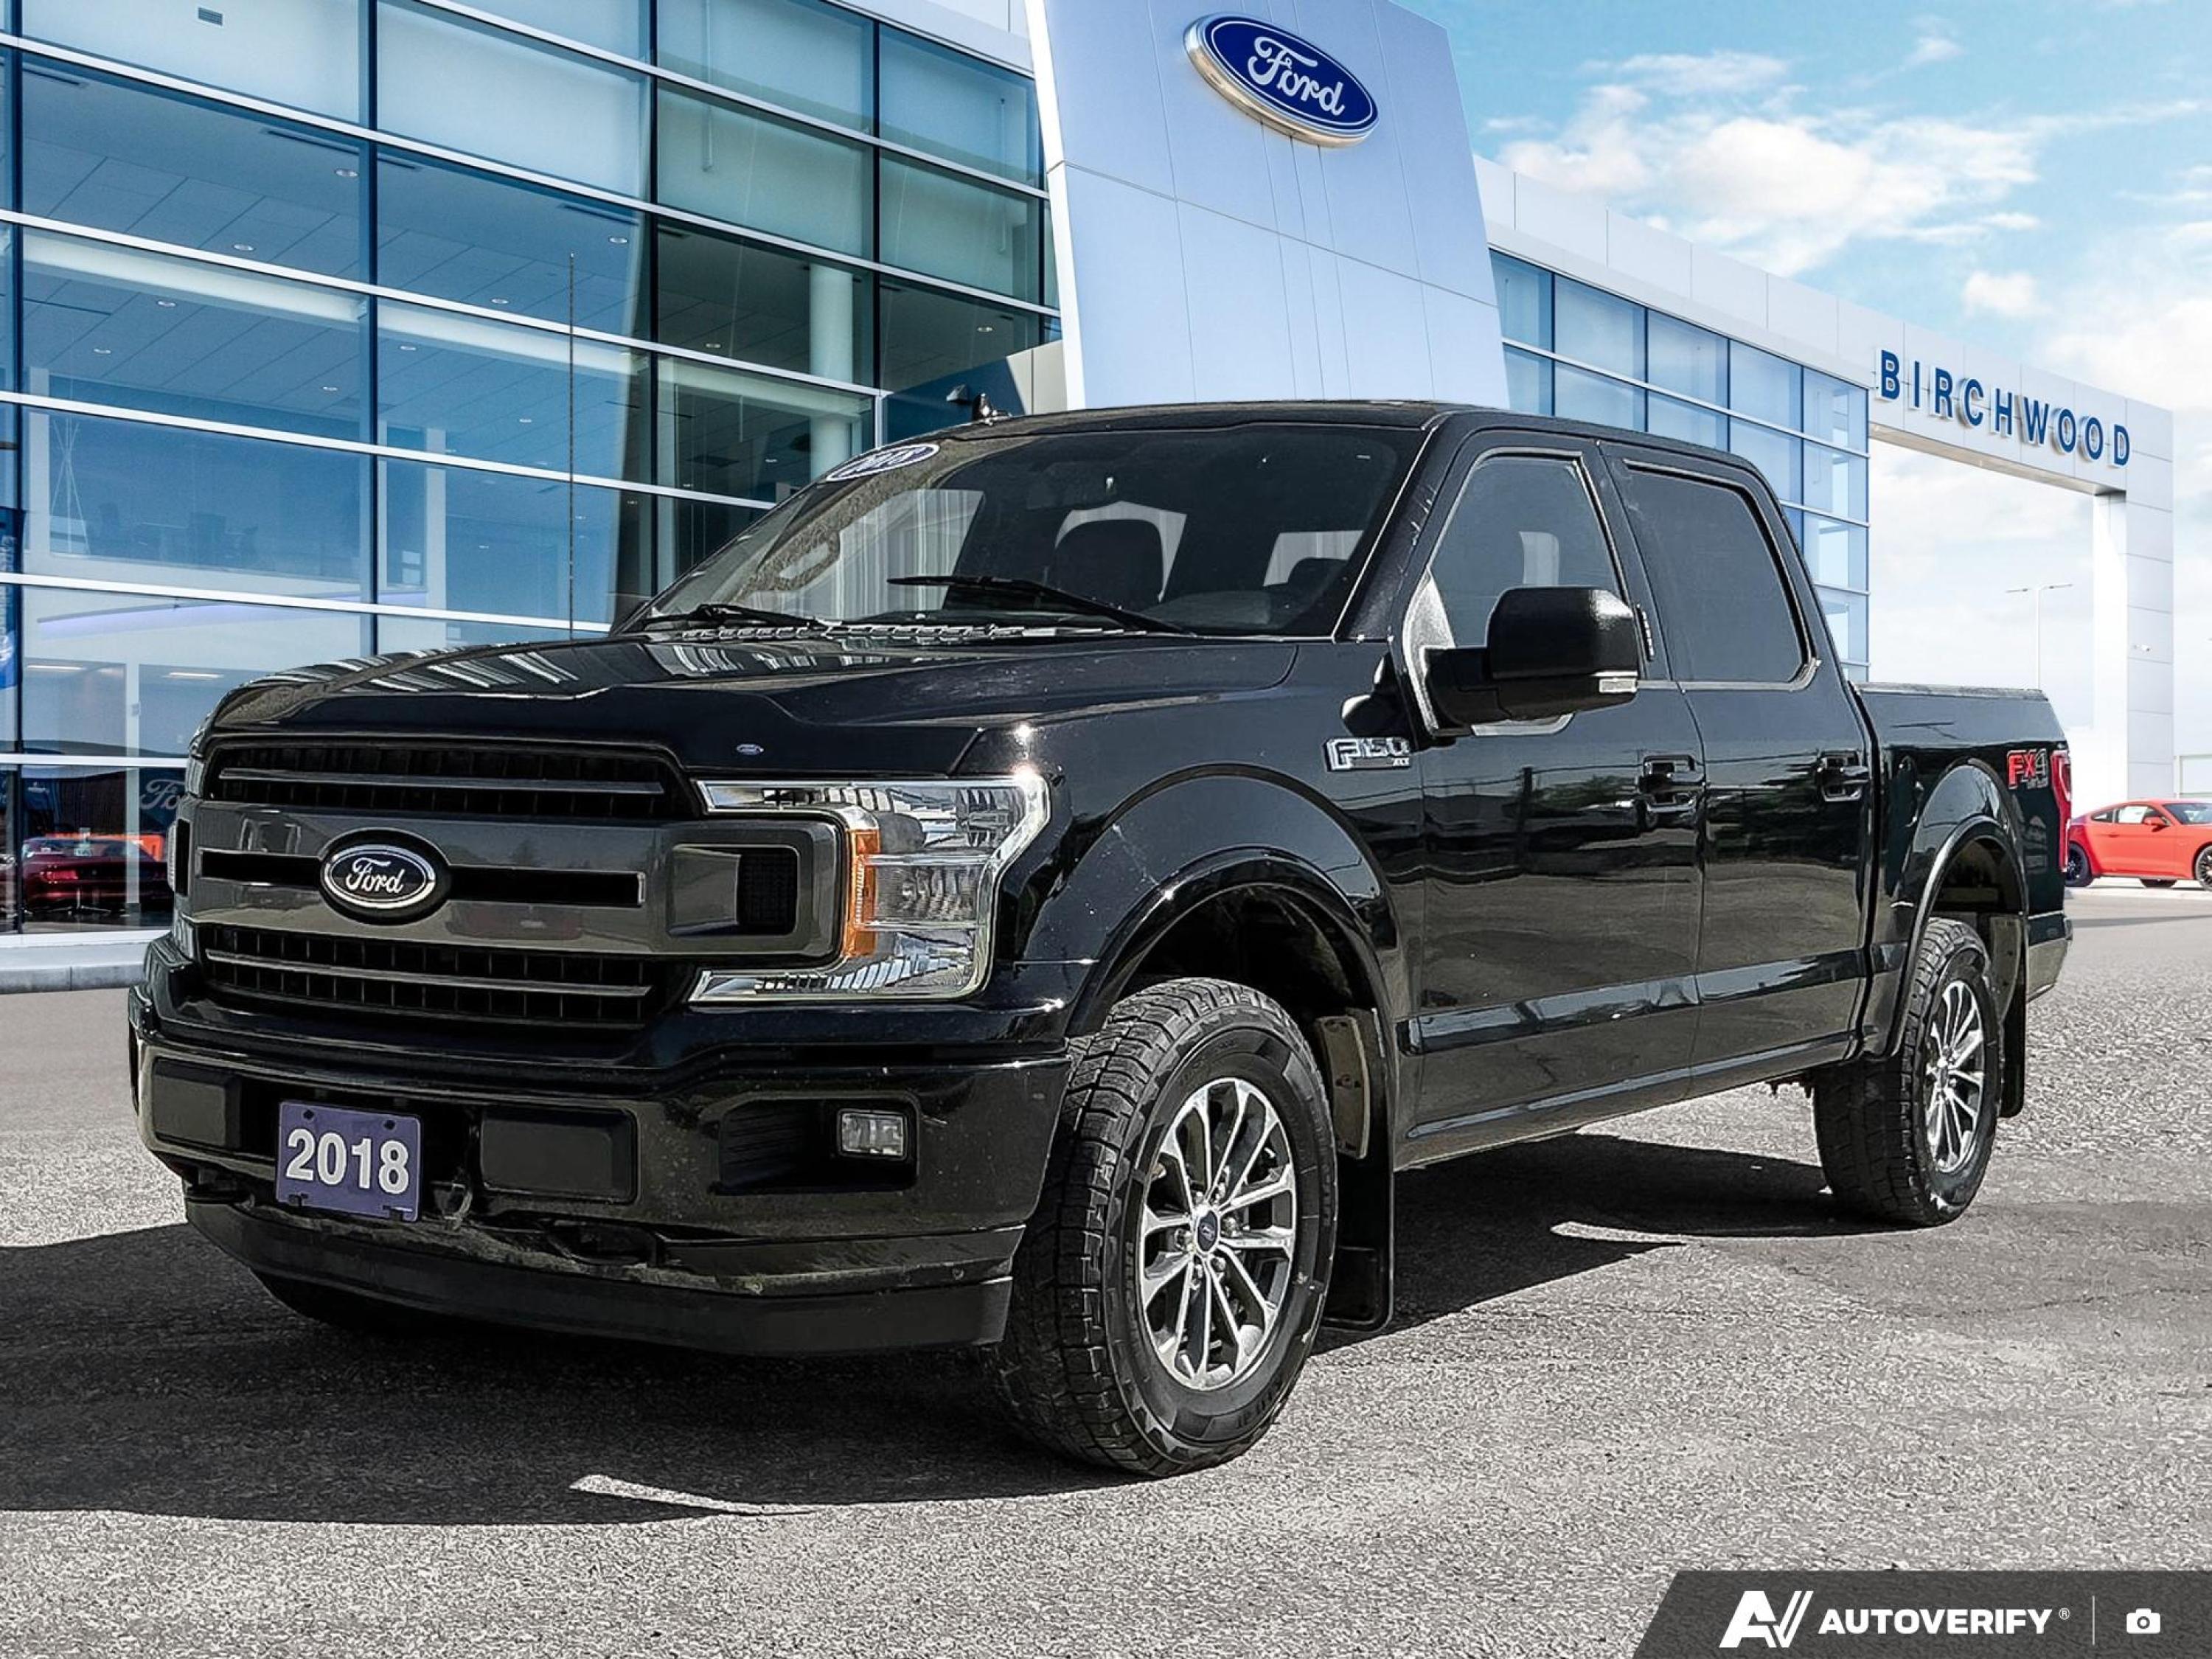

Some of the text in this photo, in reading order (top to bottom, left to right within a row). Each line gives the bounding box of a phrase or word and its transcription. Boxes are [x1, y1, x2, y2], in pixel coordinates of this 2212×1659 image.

[1248, 35, 1346, 116] Ford
[1879, 349, 2131, 467] BIRCHWOOD
[2007, 748, 2049, 790] FX4
[345, 857, 406, 894] Ford
[285, 1128, 409, 1194] 2018
